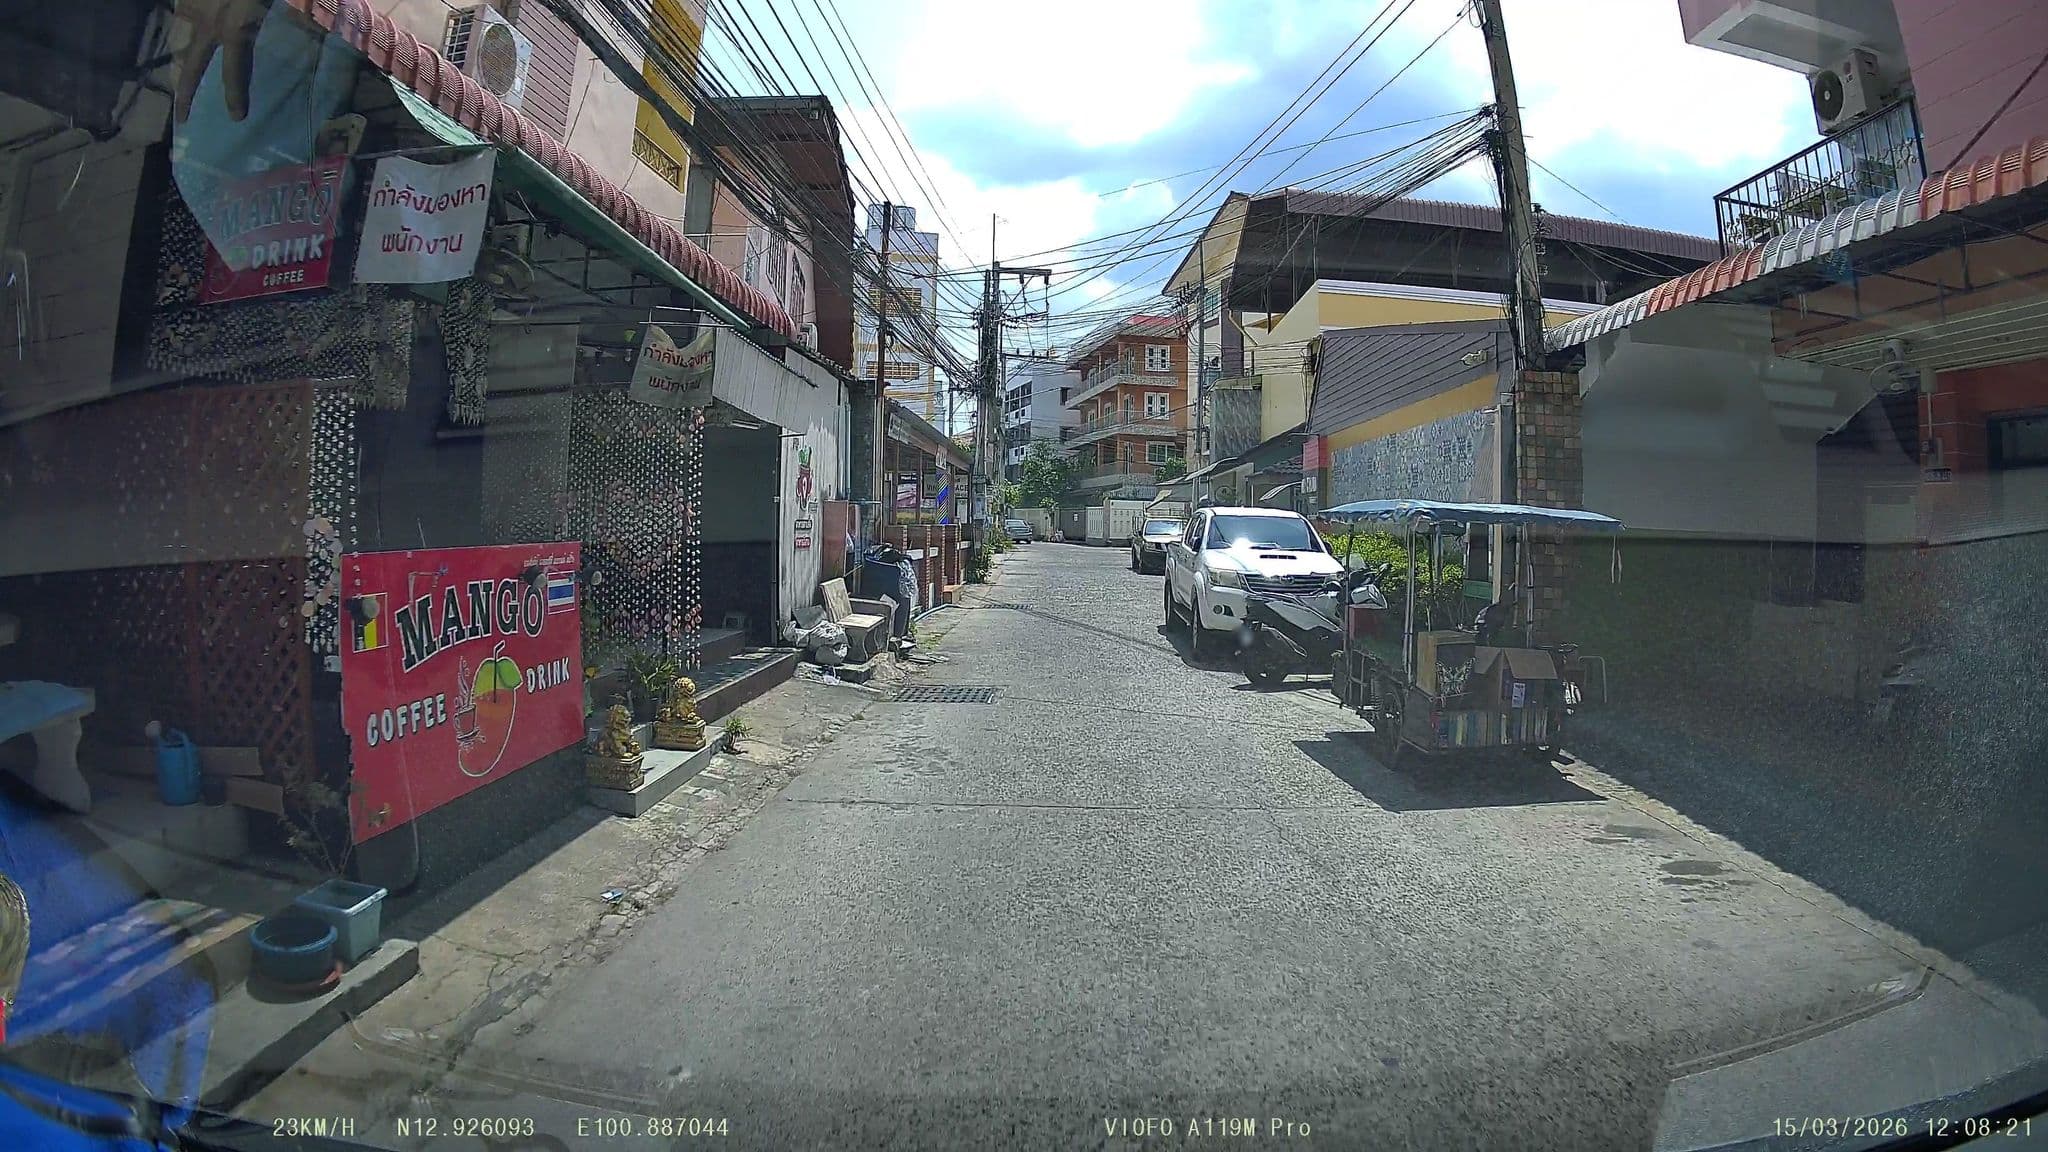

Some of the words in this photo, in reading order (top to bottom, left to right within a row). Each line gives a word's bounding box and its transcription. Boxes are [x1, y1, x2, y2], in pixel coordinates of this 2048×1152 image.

[214, 180, 334, 241] MANGO
[252, 234, 325, 269] DRINK
[382, 226, 463, 255] พนักงาน
[263, 269, 305, 287] COFFEE
[395, 578, 544, 674] MANGO
[526, 657, 571, 694] DRINK
[366, 694, 448, 747] COFFEE
